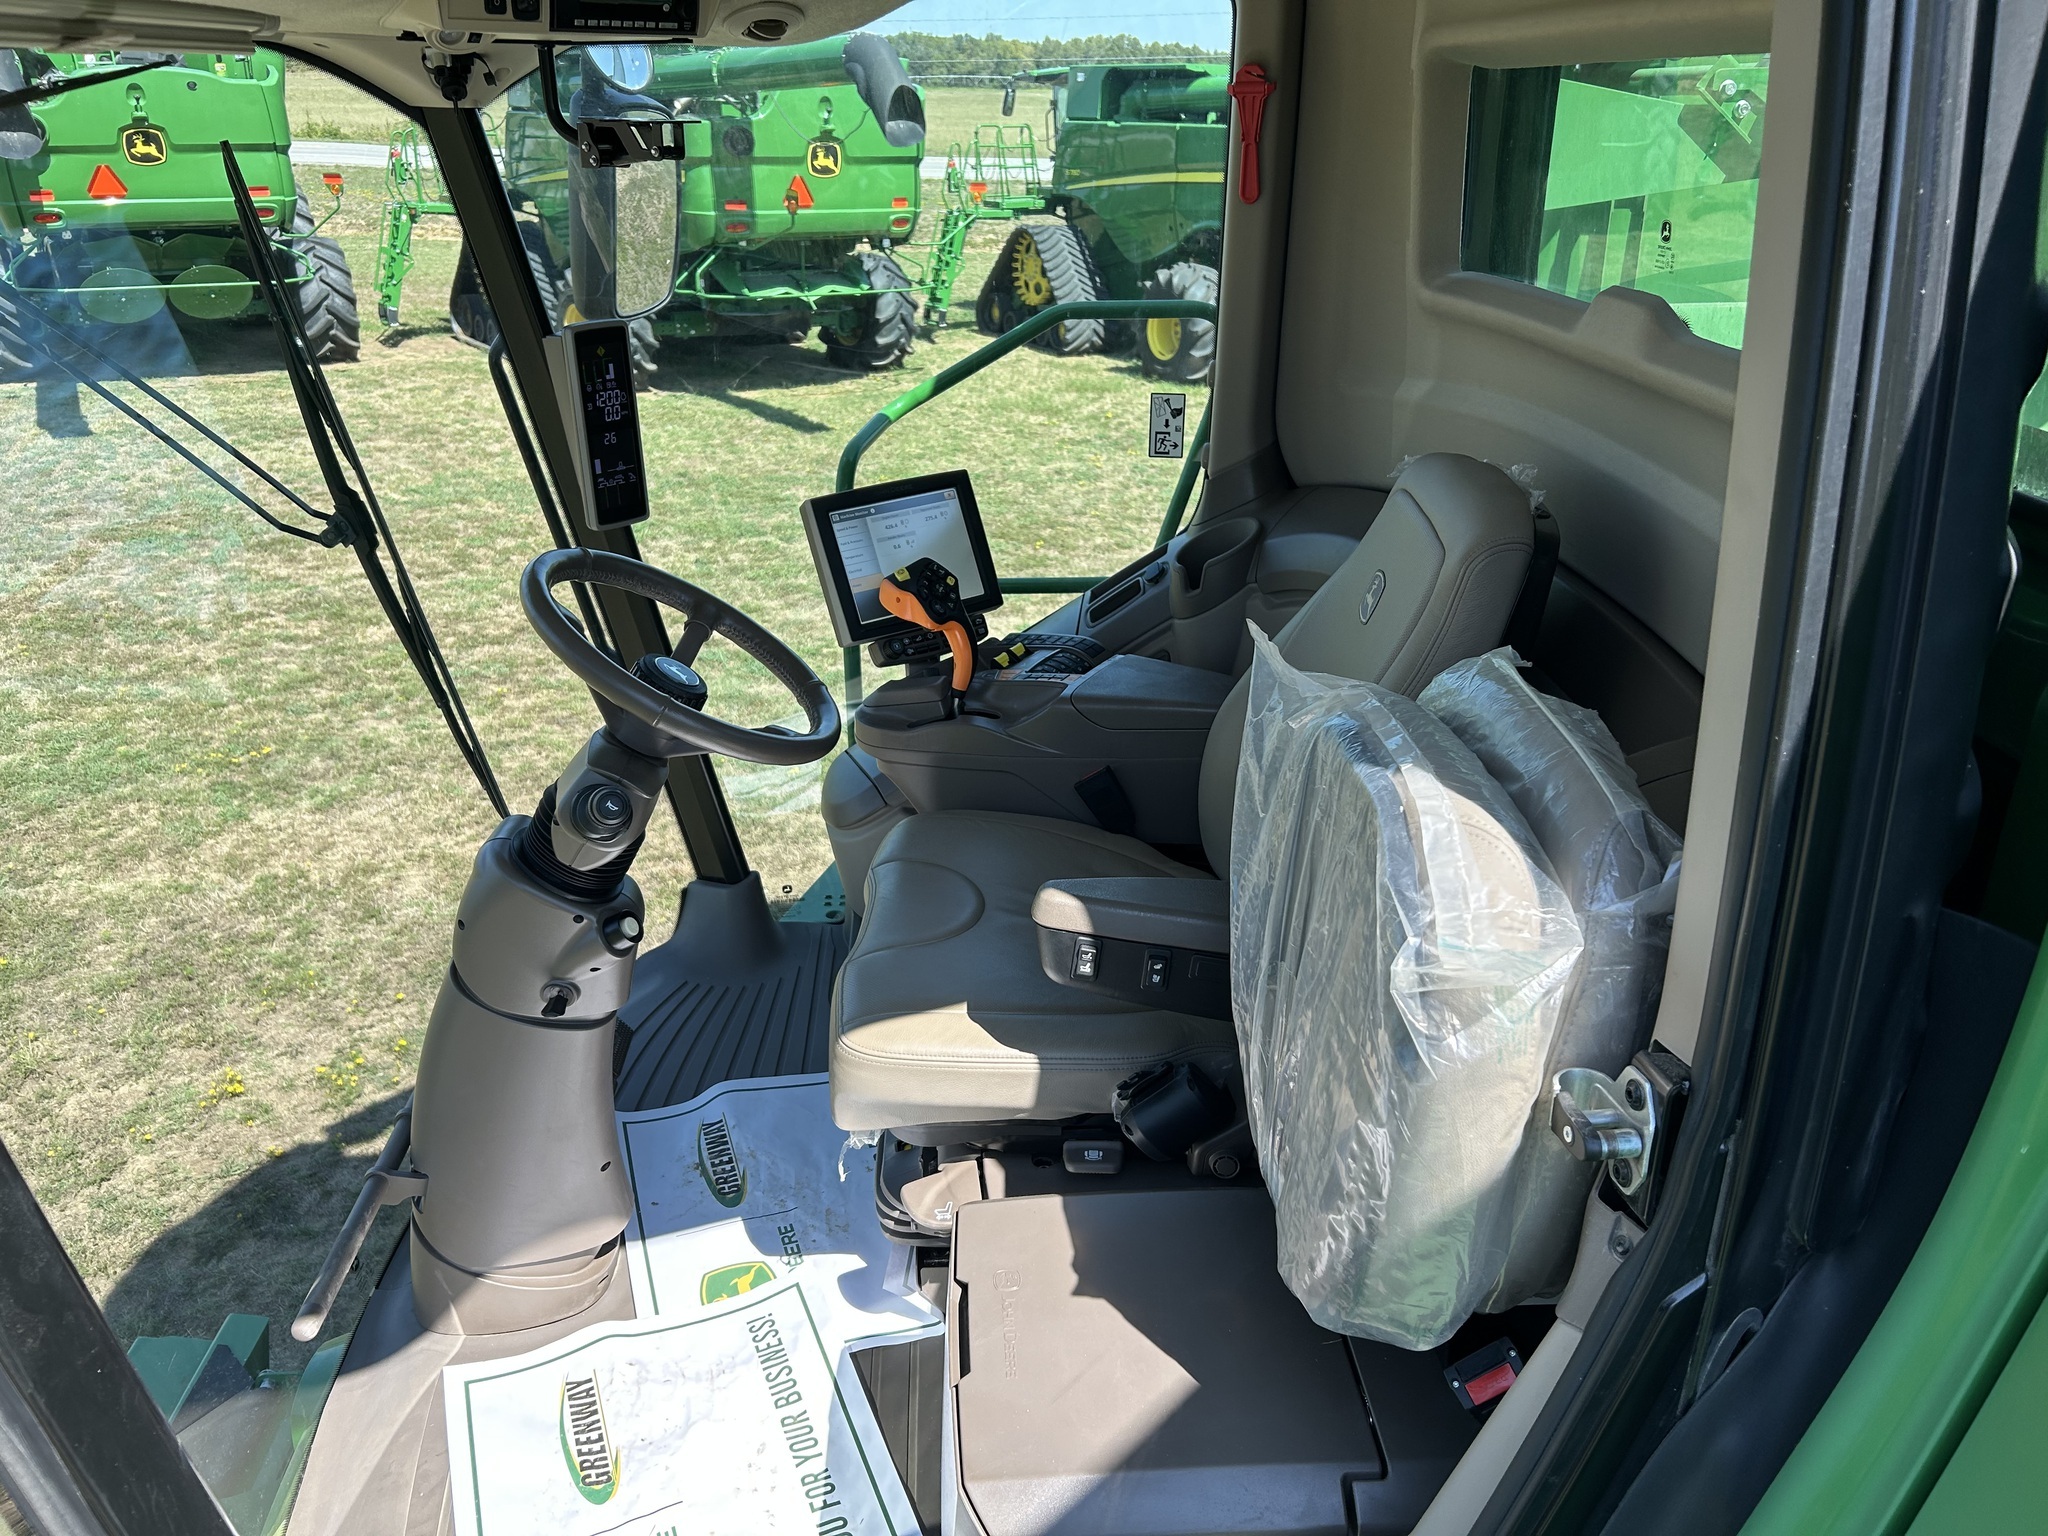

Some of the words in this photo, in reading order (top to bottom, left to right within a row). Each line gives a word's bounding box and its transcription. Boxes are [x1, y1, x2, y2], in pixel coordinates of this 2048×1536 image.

[596, 390, 620, 407] 1200
[605, 405, 620, 421] 0.0
[604, 432, 616, 444] 26
[702, 1119, 742, 1196] GREENWAY
[746, 1313, 803, 1409] BUSINESS!
[565, 1377, 613, 1486] GREENWAY
[780, 1409, 823, 1468] YOUR
[801, 1467, 841, 1513] FOR
